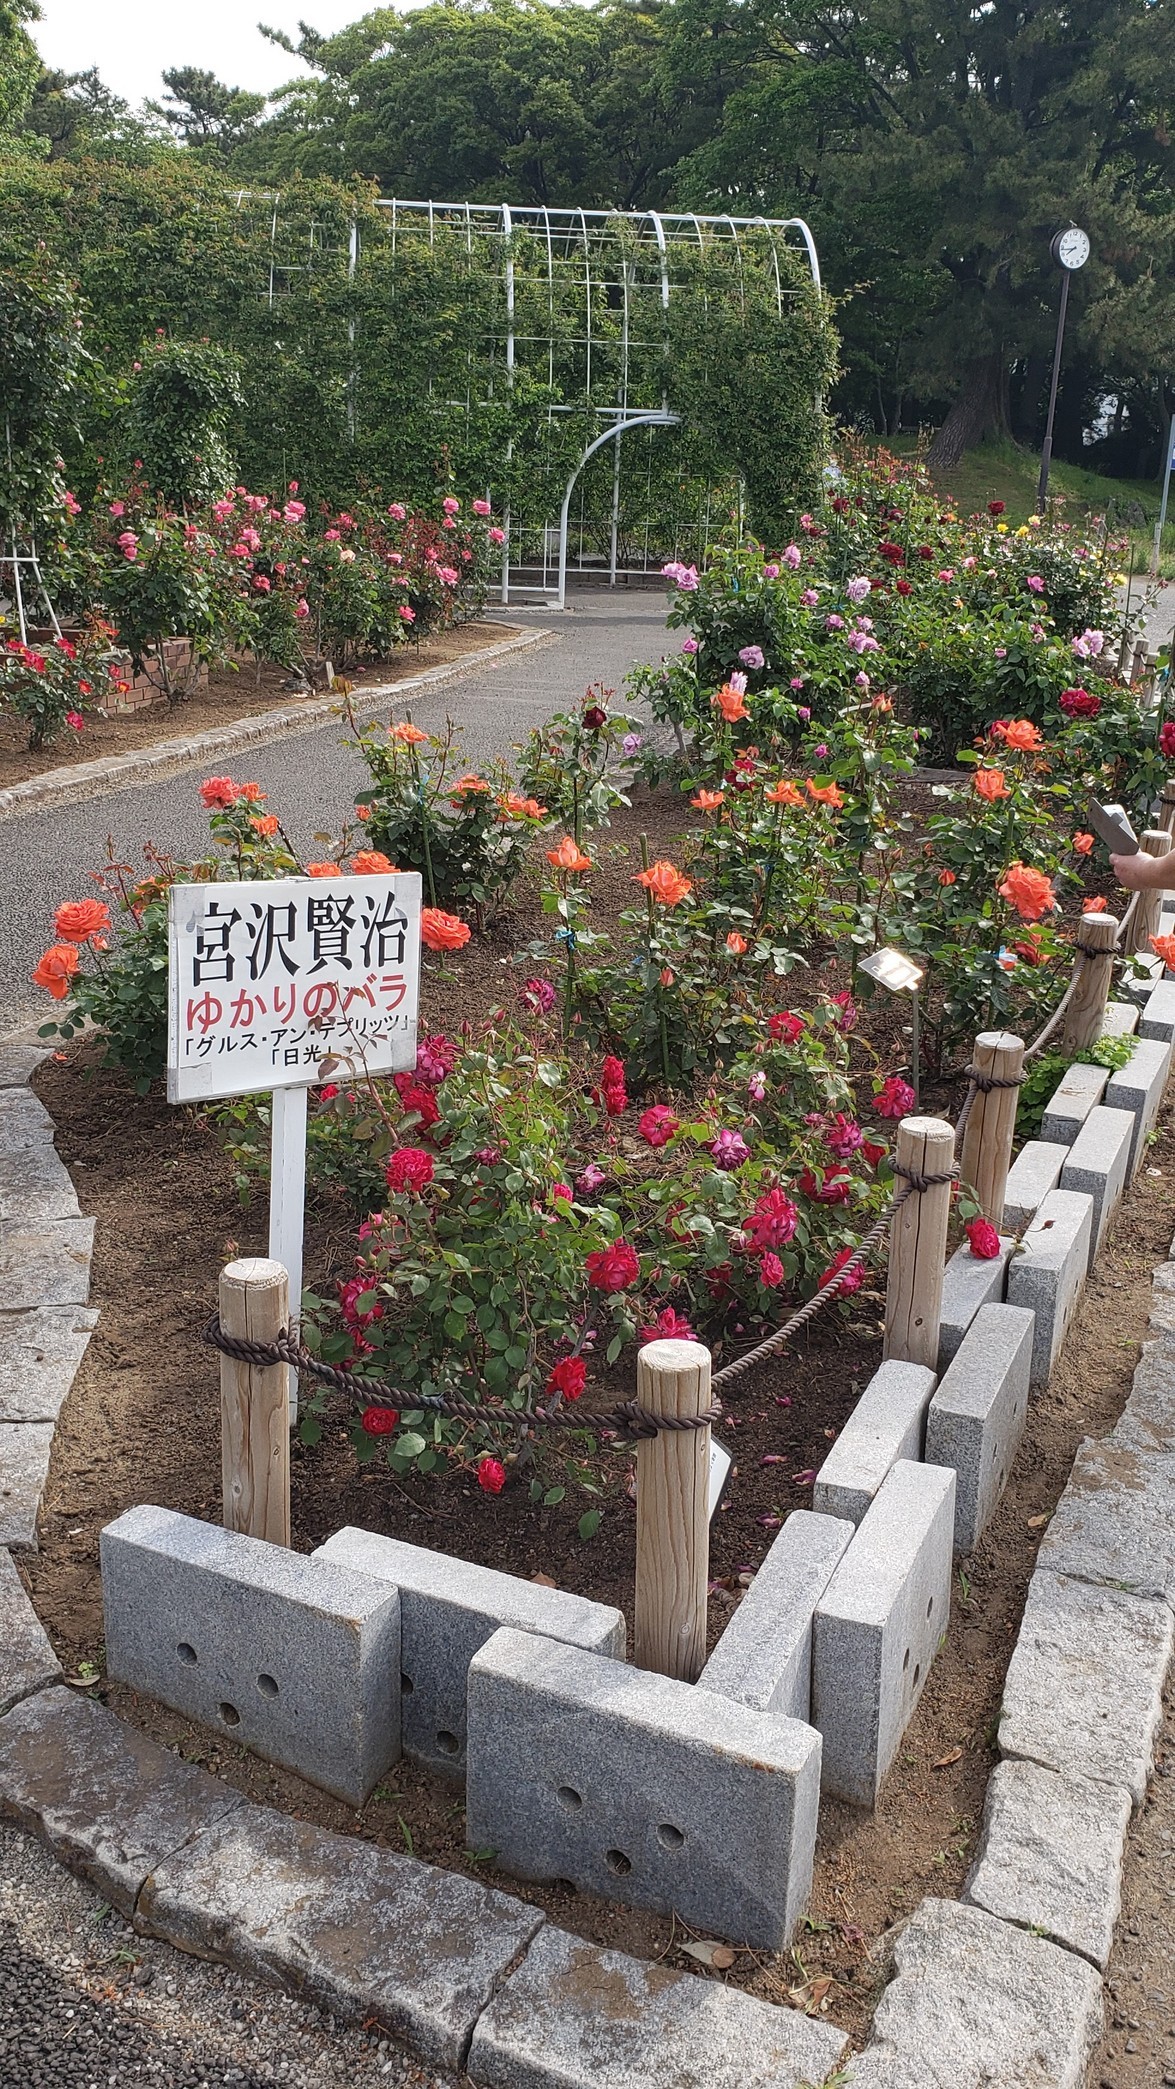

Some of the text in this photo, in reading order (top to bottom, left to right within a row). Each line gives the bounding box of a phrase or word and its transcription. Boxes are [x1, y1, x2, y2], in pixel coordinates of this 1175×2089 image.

[186, 891, 408, 987] 宮沢賢治
[187, 973, 407, 1034] ゆかりのバラ
[185, 1015, 408, 1058] 「グルス・アン・テプリッツ」
